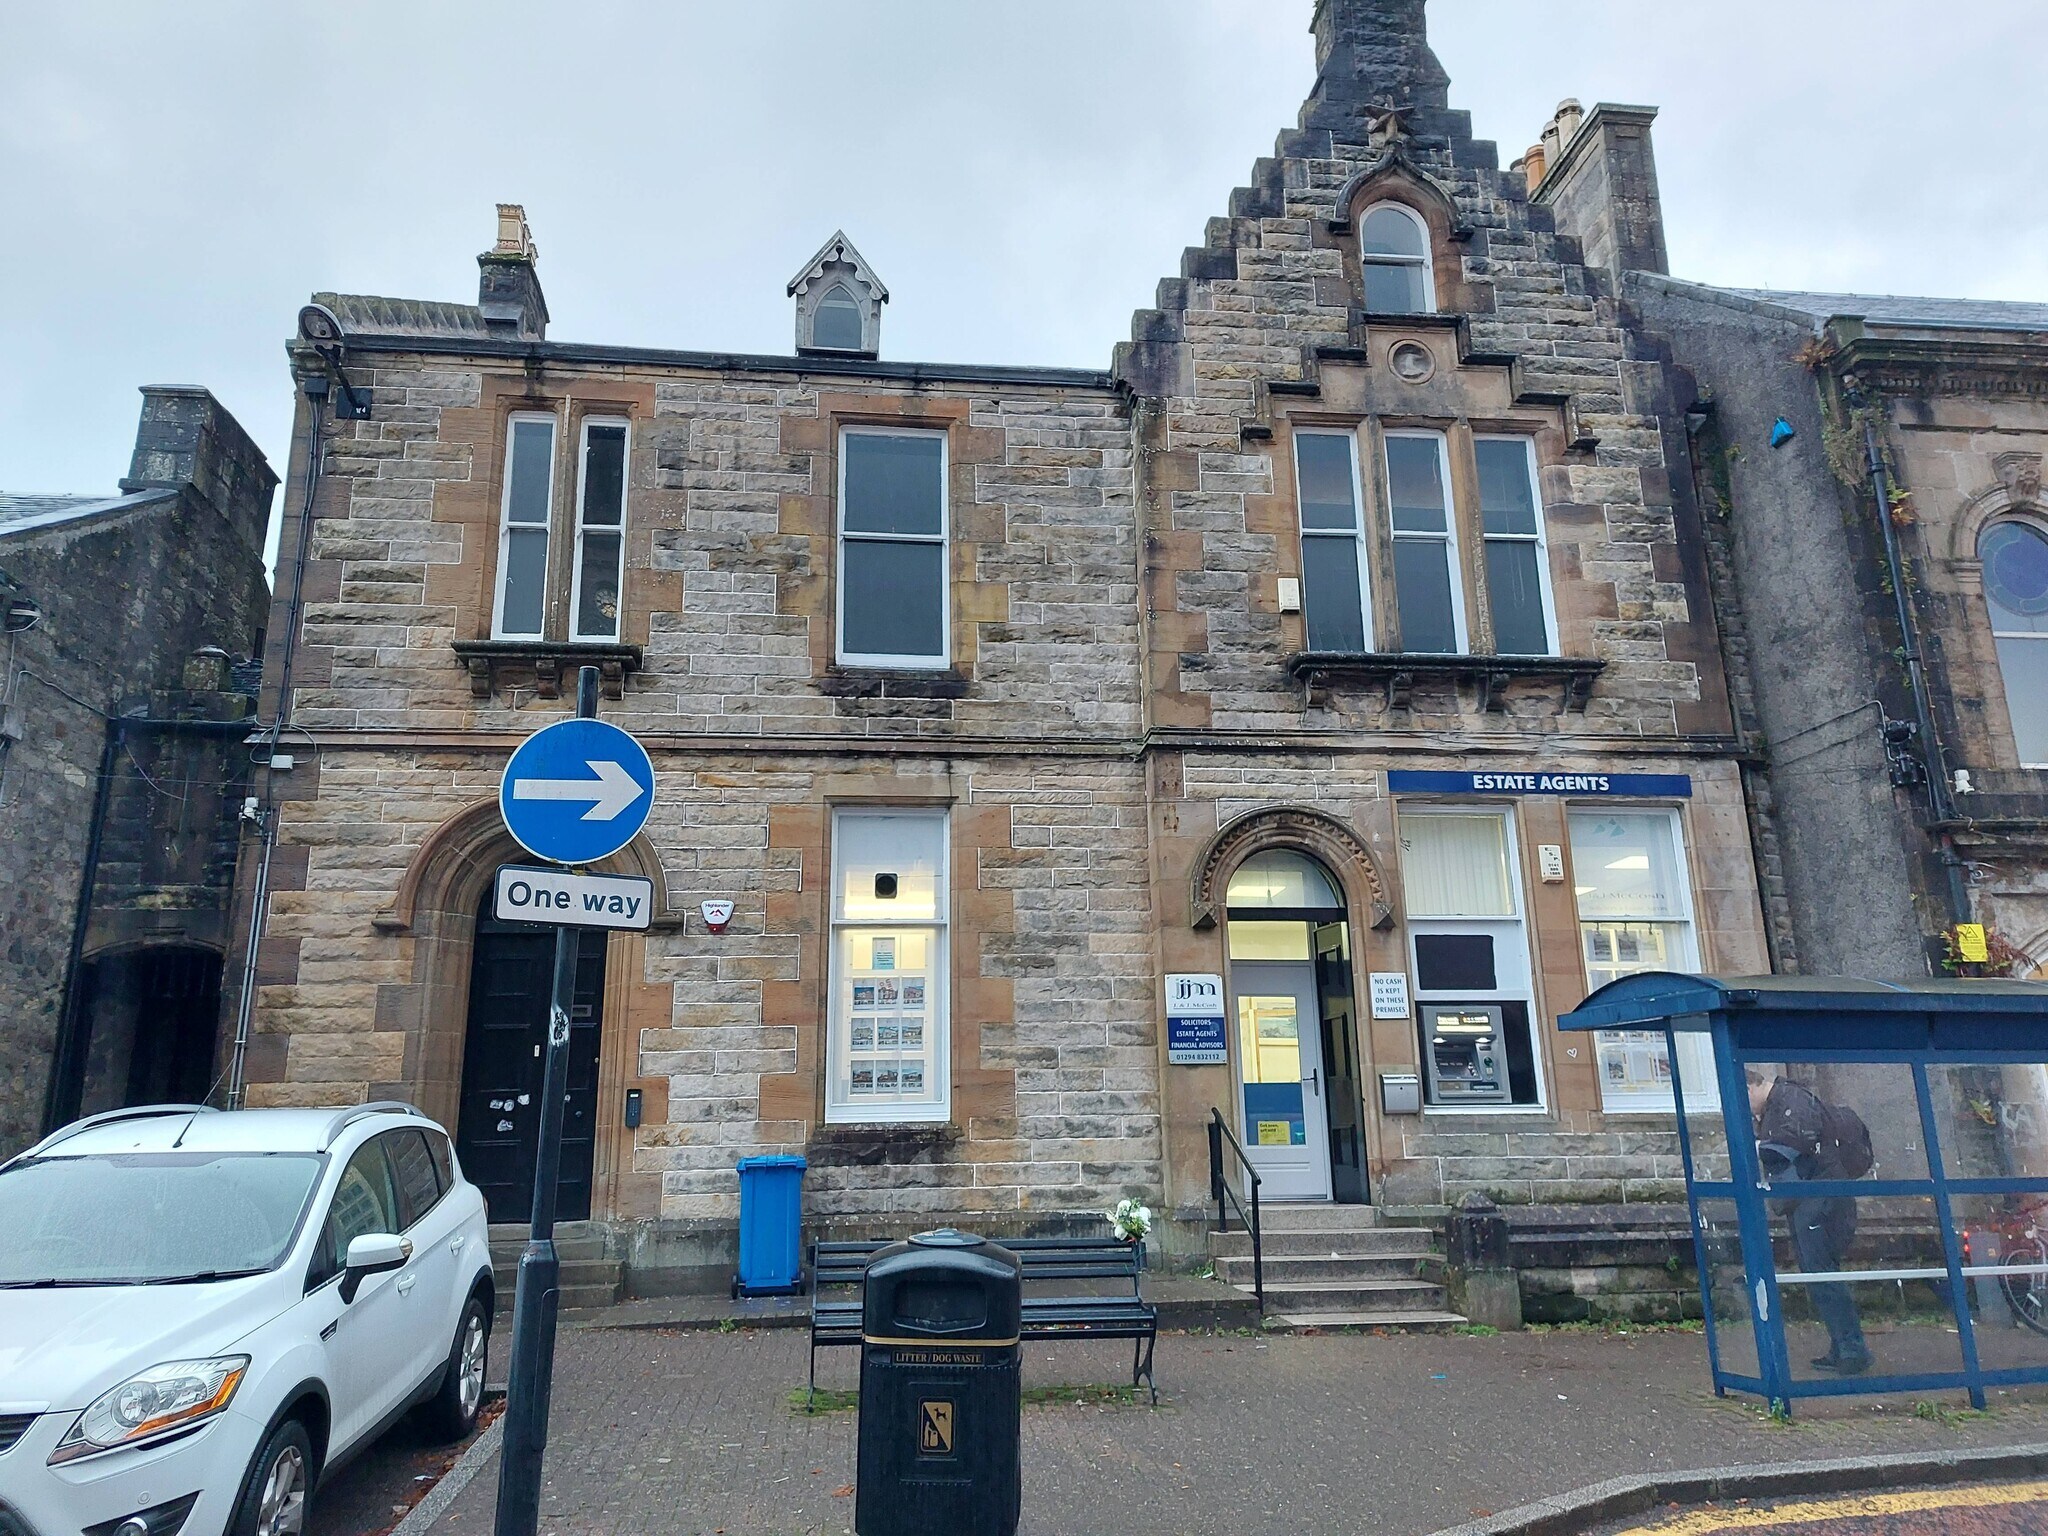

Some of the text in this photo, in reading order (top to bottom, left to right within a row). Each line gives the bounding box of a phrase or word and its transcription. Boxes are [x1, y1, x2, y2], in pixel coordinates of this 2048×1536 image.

[1472, 775, 1610, 791] ESTATE AGENTS
[507, 881, 642, 919] One way
[896, 1352, 927, 1362] LITTER
[932, 1353, 952, 1363] DOG
[953, 1354, 982, 1363] WASTE
